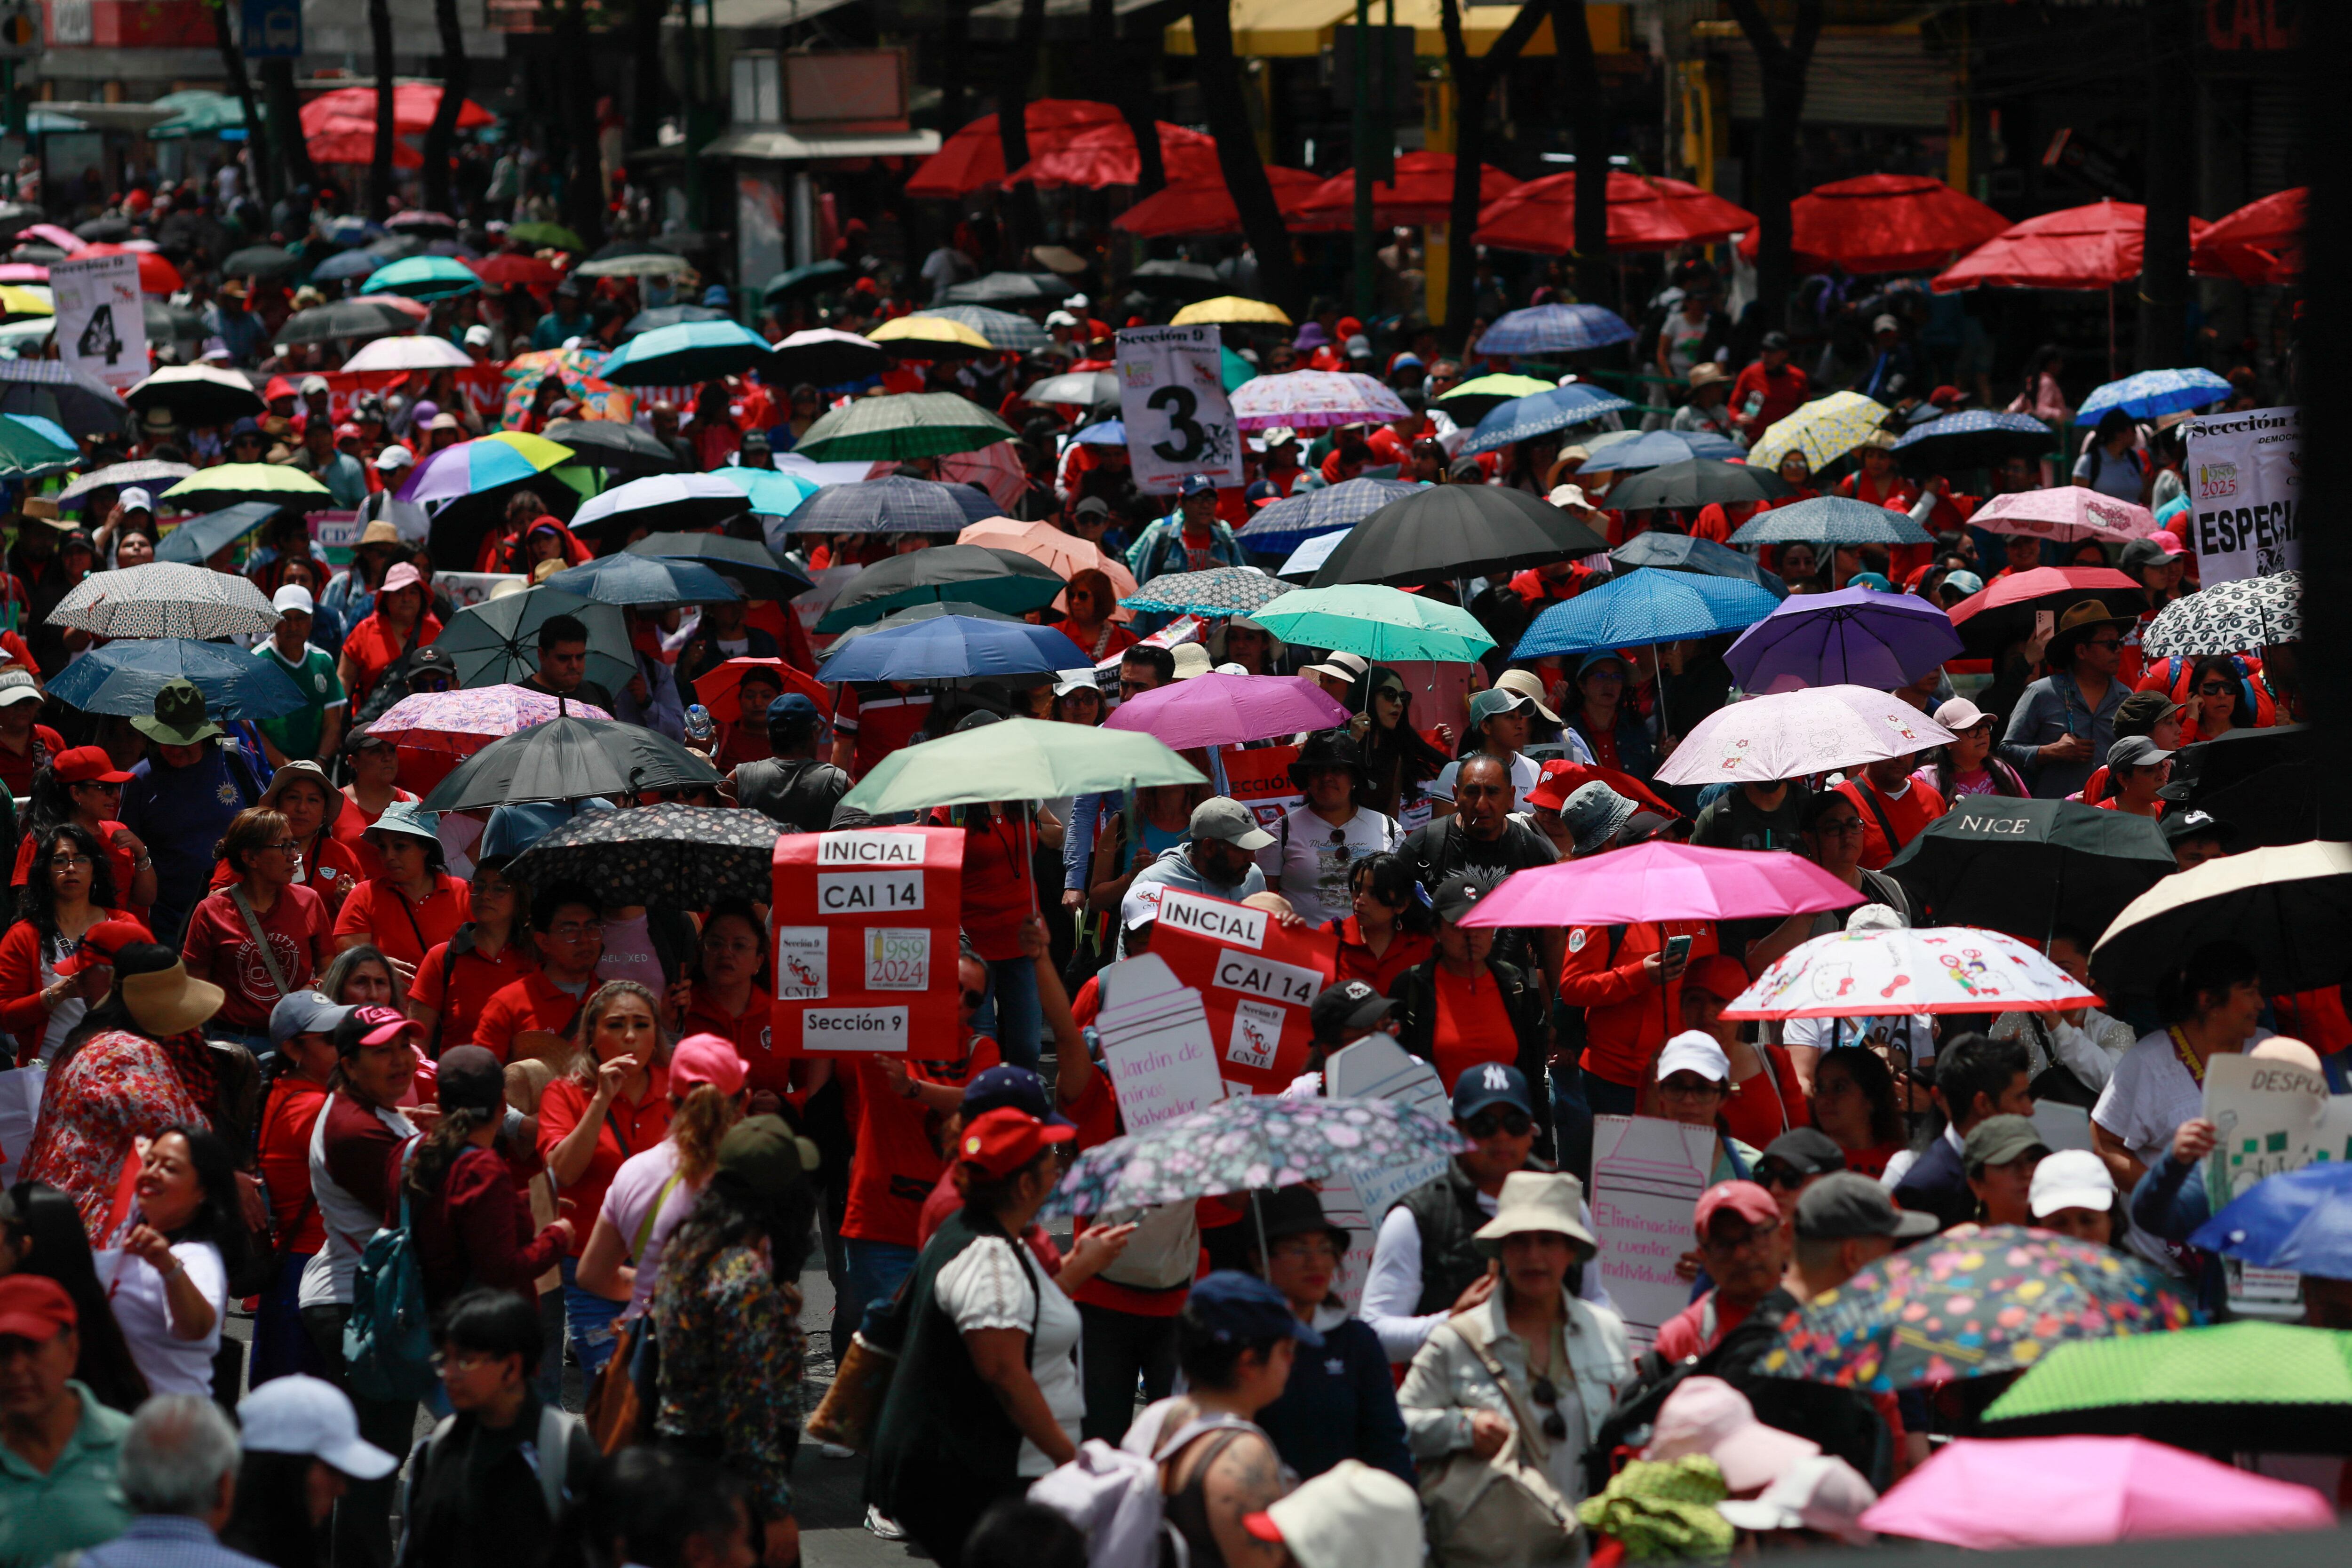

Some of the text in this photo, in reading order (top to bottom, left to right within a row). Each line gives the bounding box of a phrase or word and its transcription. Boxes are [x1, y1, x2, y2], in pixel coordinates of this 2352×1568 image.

[77, 303, 123, 365] 4
[1147, 385, 1205, 462] 3
[2192, 414, 2287, 438] Sección
[2201, 479, 2236, 497] 2025
[1959, 815, 2030, 834] NICE
[825, 842, 917, 861] INICIAL
[824, 883, 916, 908] CAI 14
[1166, 902, 1256, 941] INICIAL
[871, 960, 924, 984] 2024
[1221, 963, 1312, 1003] CAI 14
[785, 986, 821, 997] CNTE
[808, 1013, 902, 1031] Sección 9
[1178, 1042, 1204, 1062] de
[1233, 1050, 1269, 1068] CNTE
[1130, 1097, 1198, 1129] Salvador
[1617, 1240, 1673, 1258] cuentas
